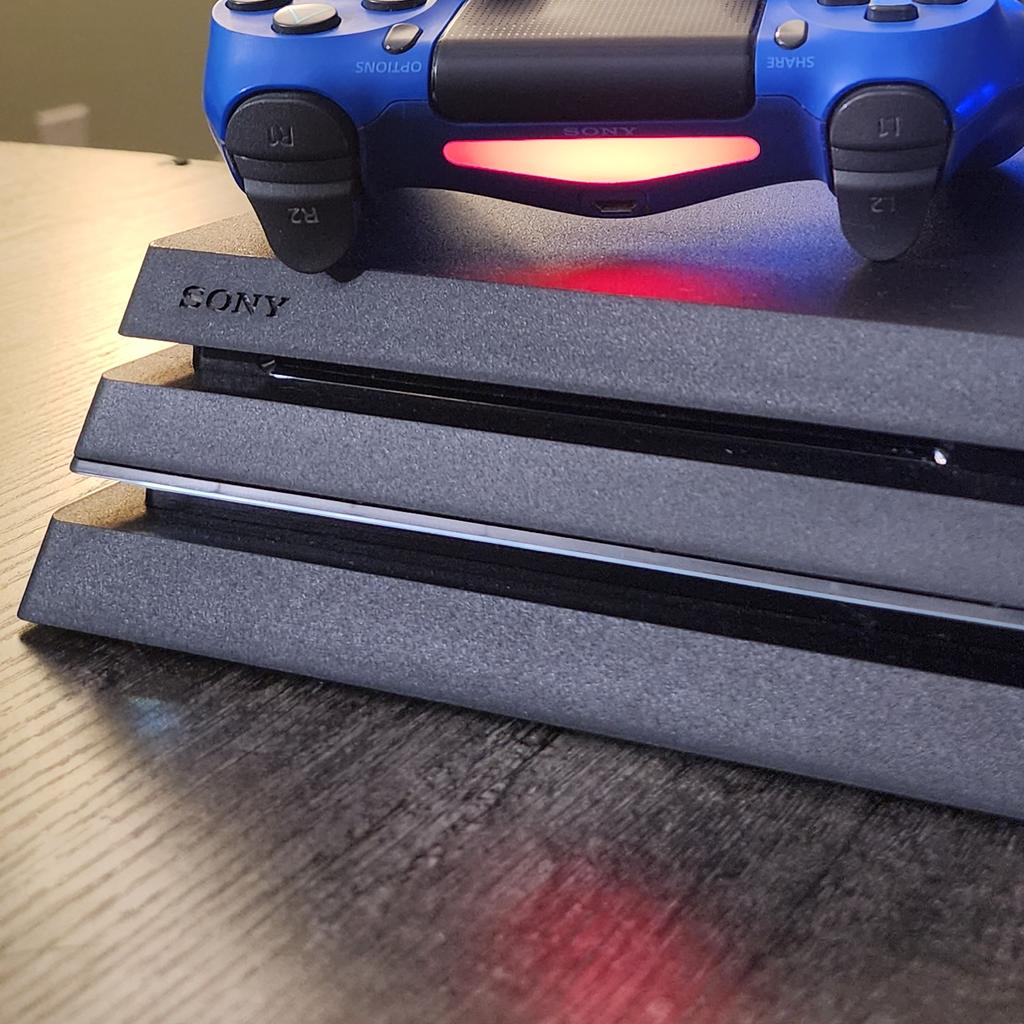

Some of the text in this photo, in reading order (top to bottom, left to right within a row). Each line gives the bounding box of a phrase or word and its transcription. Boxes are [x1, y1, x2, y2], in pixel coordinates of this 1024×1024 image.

[355, 60, 422, 74] OPTIONS
[766, 56, 815, 69] SHARE
[561, 127, 637, 136] SONY
[879, 117, 900, 137] L1
[268, 126, 295, 147] R1
[870, 196, 896, 213] L2
[287, 207, 319, 224] R2
[179, 285, 290, 318] SONY
